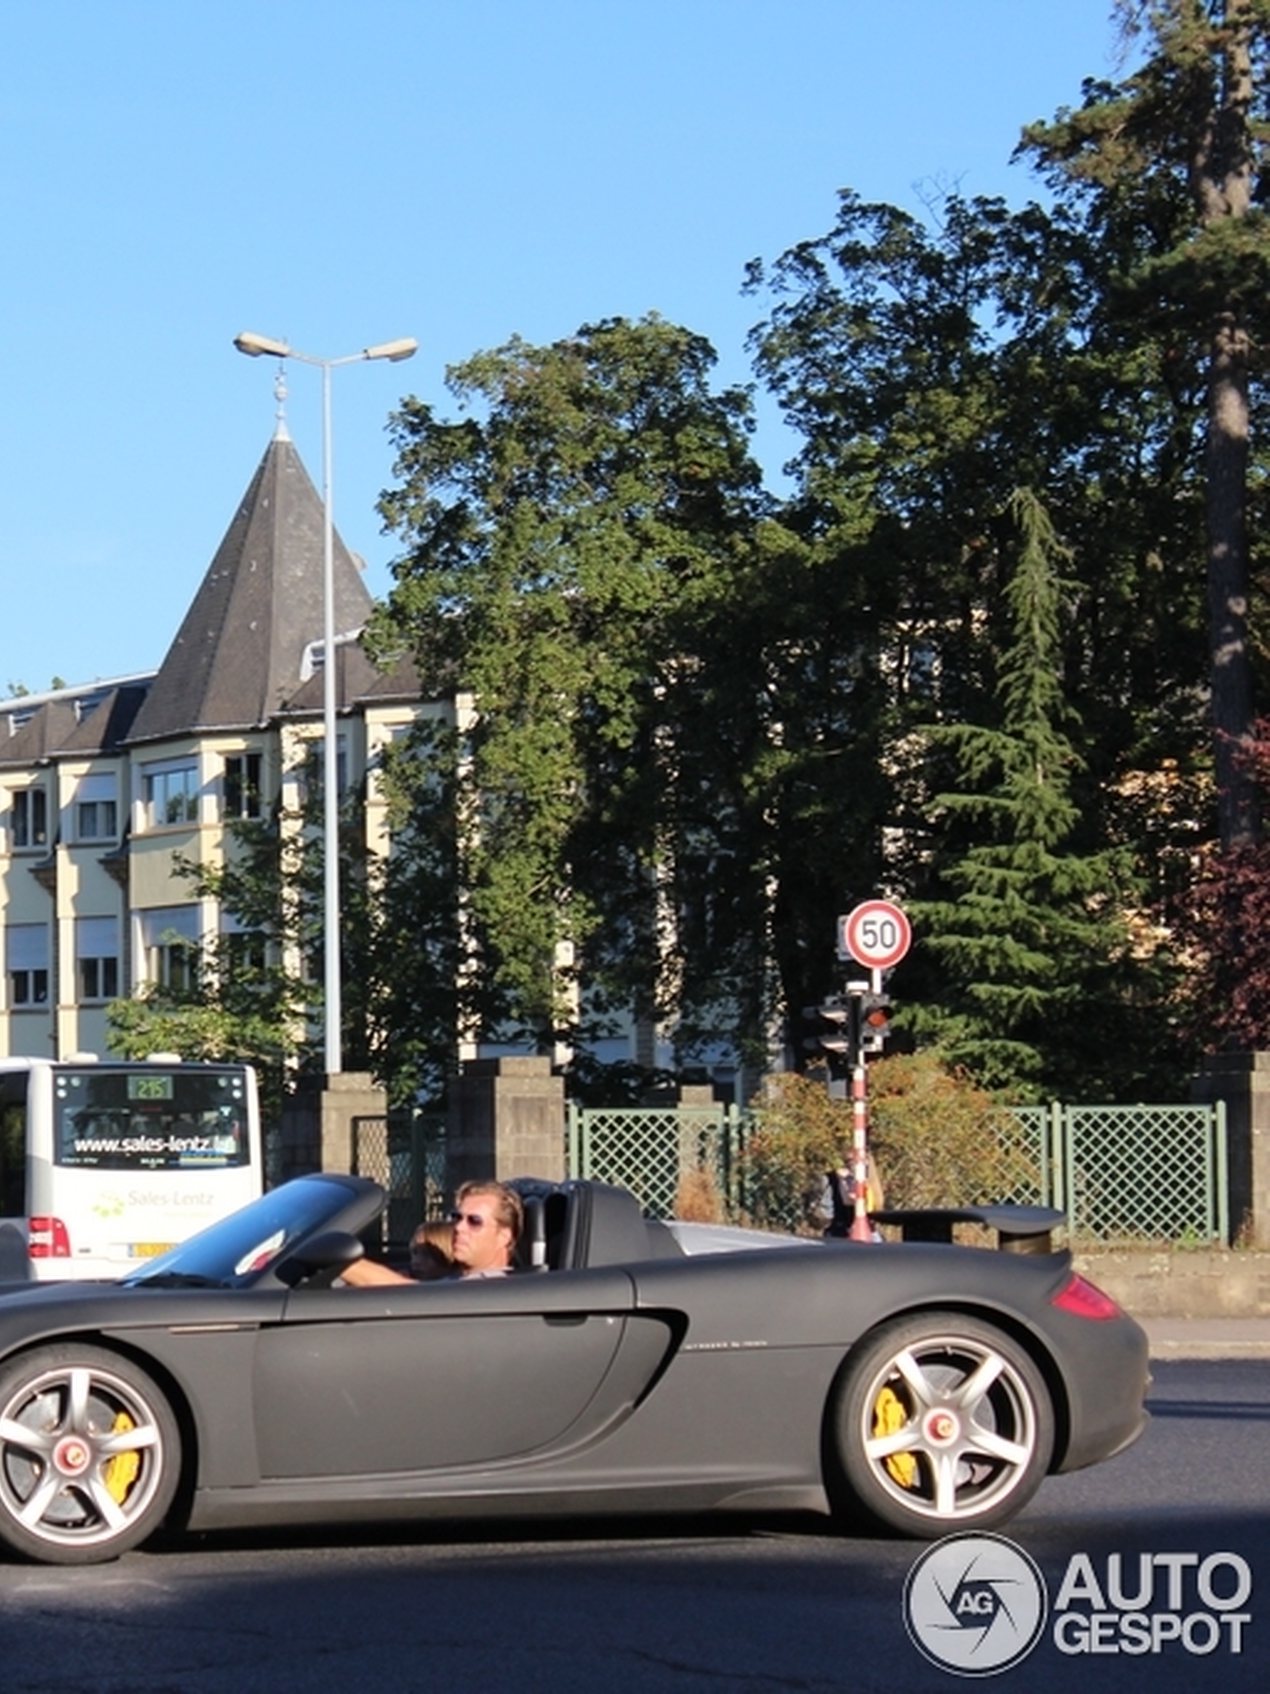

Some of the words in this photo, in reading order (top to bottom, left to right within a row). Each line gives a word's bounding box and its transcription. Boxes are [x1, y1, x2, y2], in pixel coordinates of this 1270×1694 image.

[862, 920, 897, 949] 50
[138, 1081, 164, 1098] 215
[128, 1190, 214, 1206] Sales-Lentz
